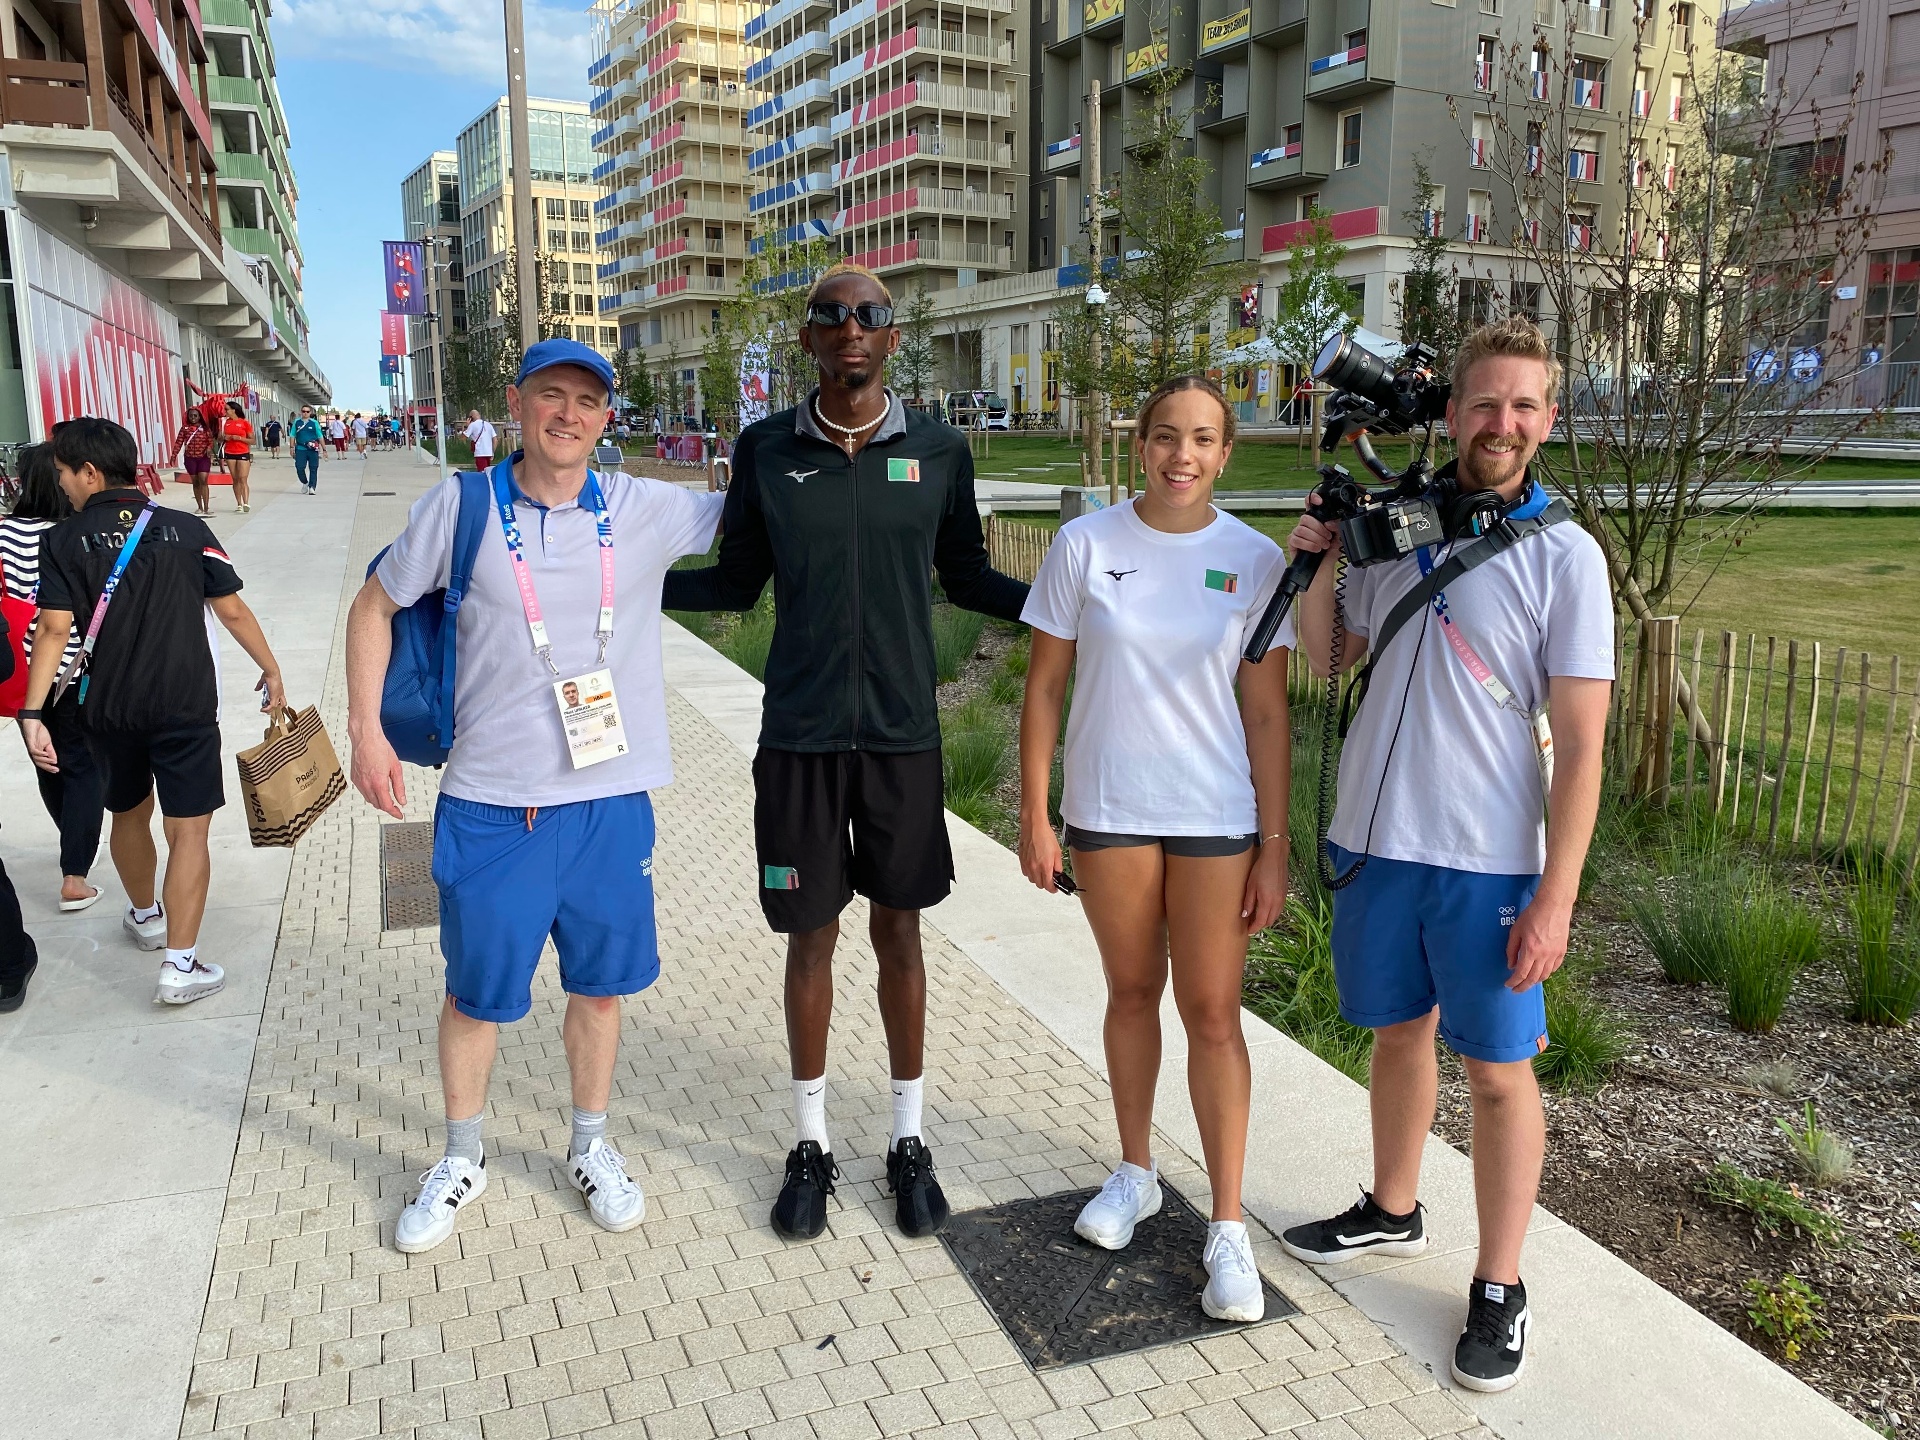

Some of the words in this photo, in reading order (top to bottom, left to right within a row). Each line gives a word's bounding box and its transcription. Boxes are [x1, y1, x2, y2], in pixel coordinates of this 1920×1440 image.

[81, 525, 179, 552] INDOESIA
[518, 565, 531, 590] 2024
[525, 592, 538, 619] PARIS
[1449, 628, 1466, 652] 2024
[1464, 652, 1486, 677] PARIS
[617, 744, 625, 753] R
[250, 793, 267, 822] VISA
[1501, 916, 1516, 926] OBS
